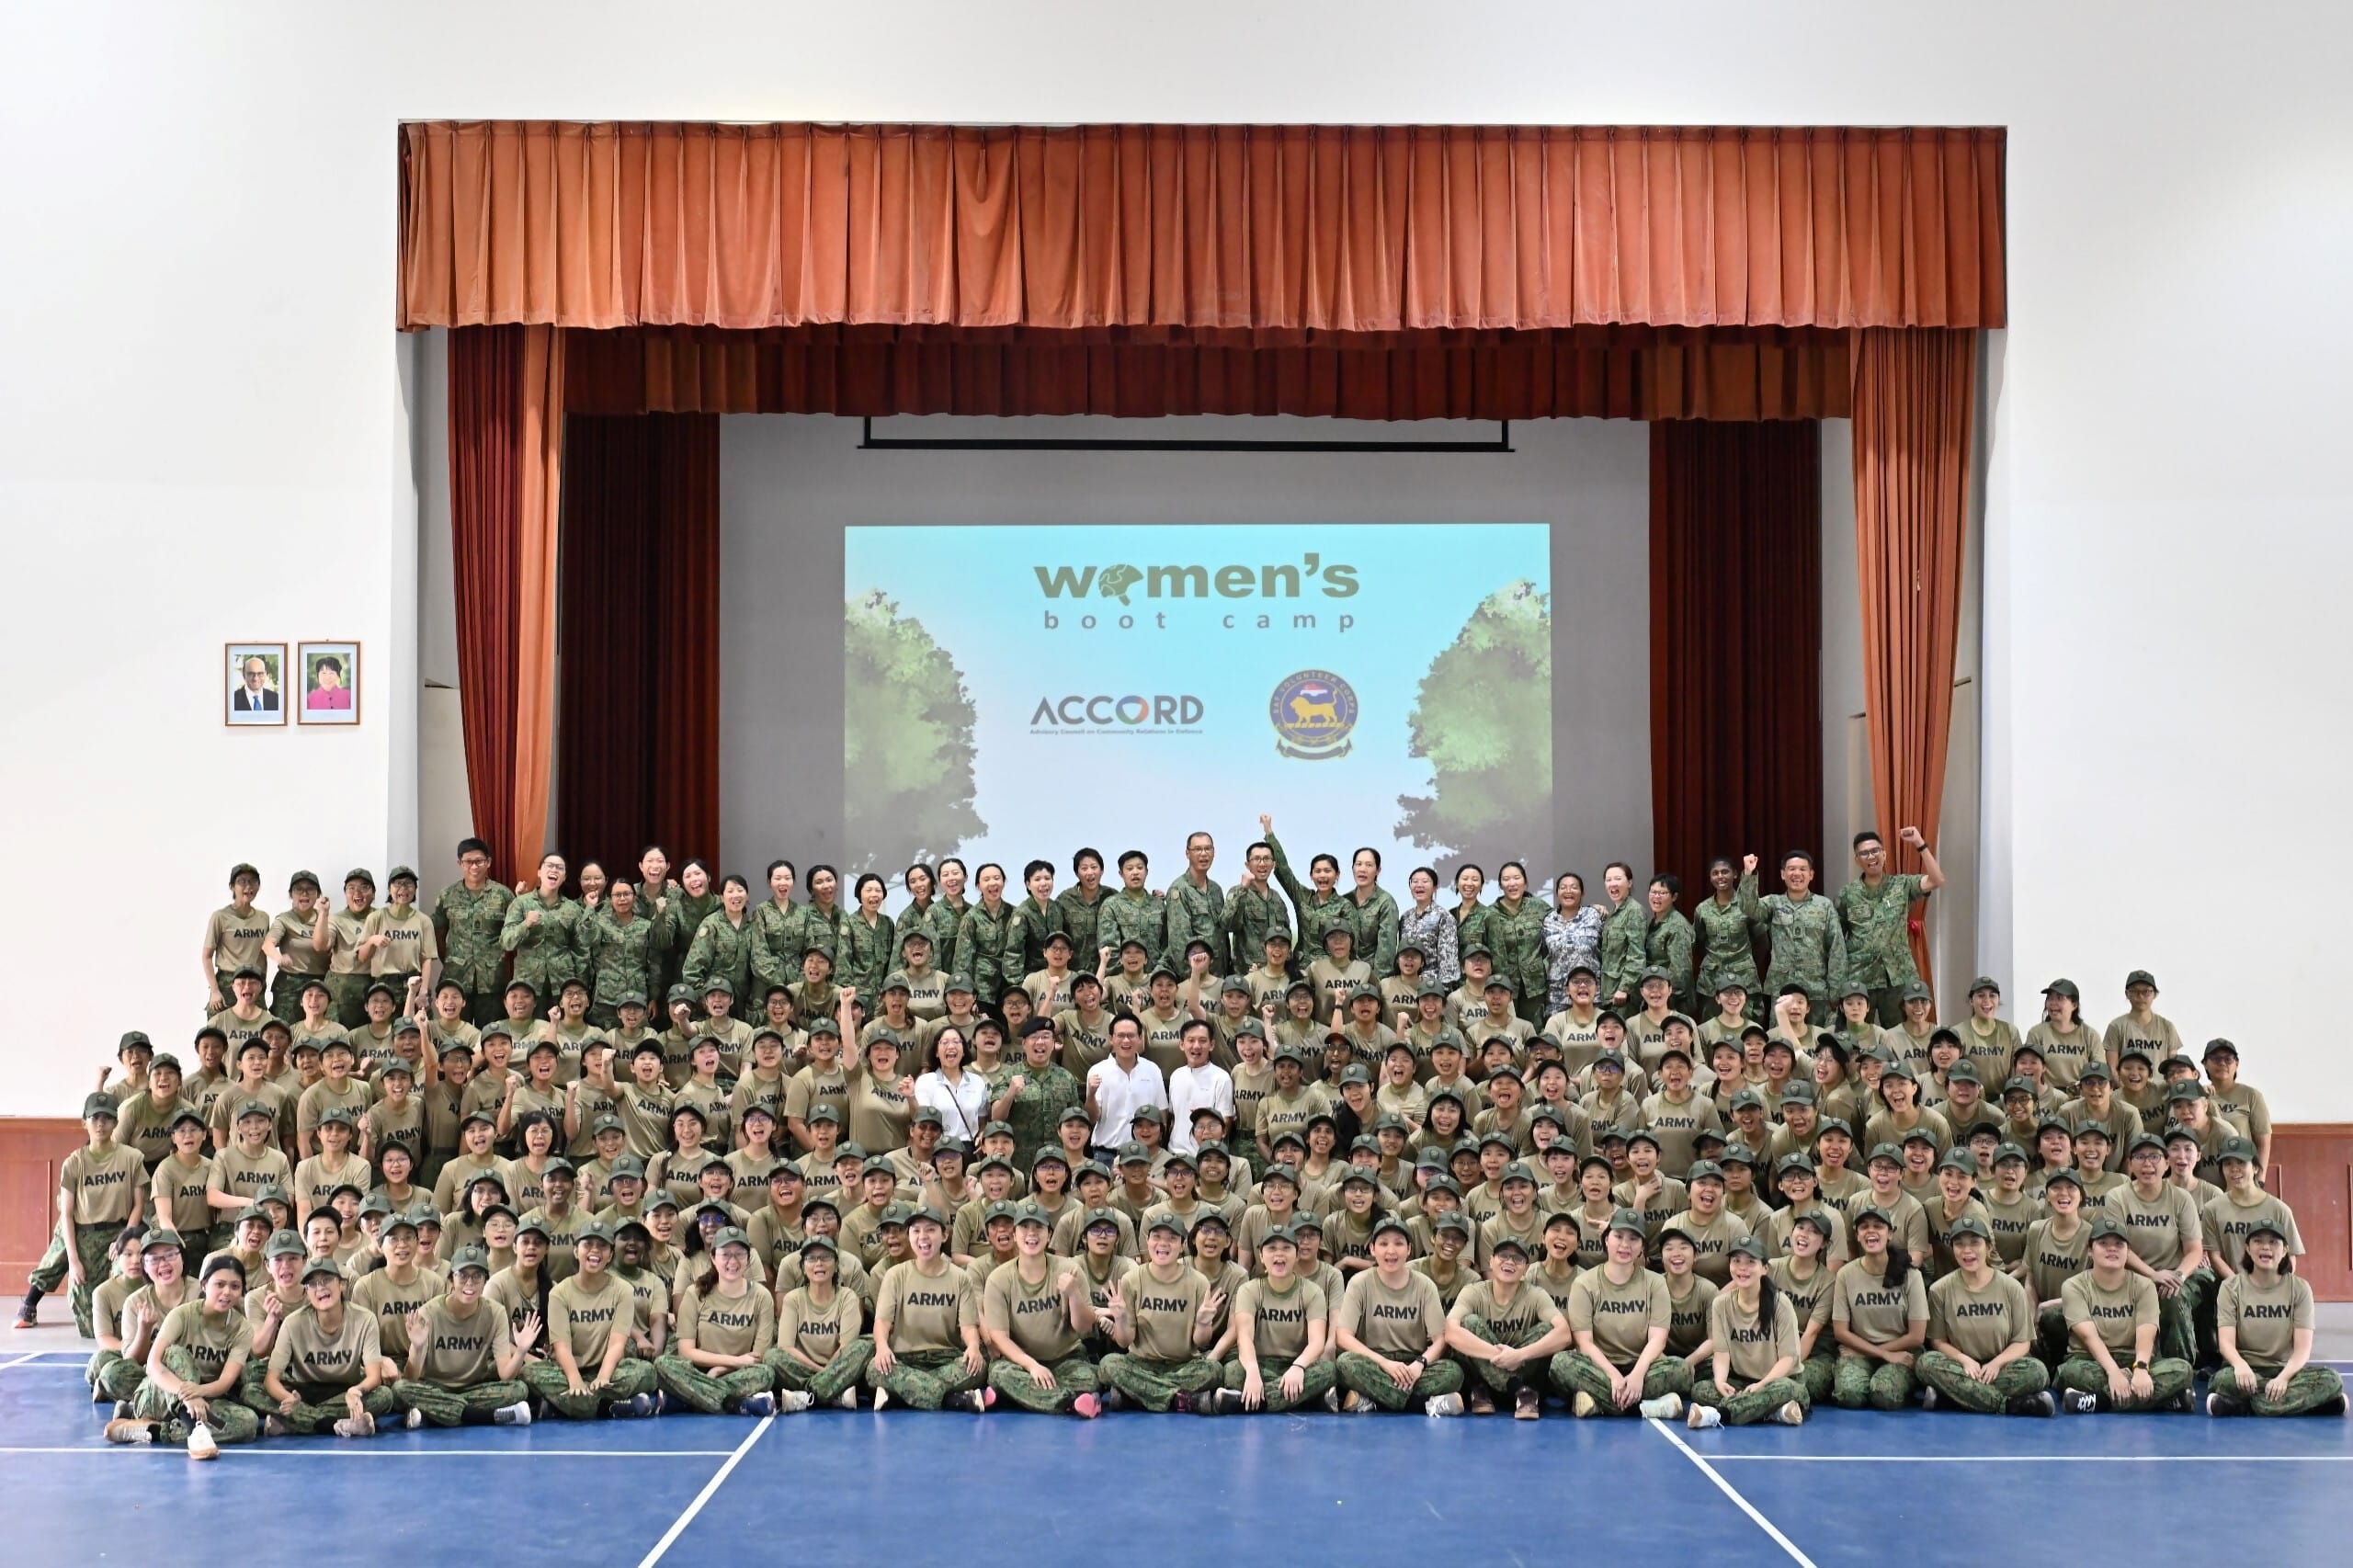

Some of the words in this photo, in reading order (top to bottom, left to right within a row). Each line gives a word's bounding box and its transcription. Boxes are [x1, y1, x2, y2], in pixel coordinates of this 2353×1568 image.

[1044, 610, 1166, 629] boot
[1222, 614, 1354, 632] camp
[1030, 695, 1204, 725] ACCORD
[233, 927, 266, 938] ARMY
[384, 929, 419, 940] ARMY
[1116, 994, 1150, 1006] ARY
[1261, 990, 1287, 1002] ARM
[1392, 994, 1419, 1005] ARM
[1072, 1029, 1106, 1048] ARMY
[1151, 1030, 1181, 1040] ARM
[1567, 1032, 1597, 1041] ARM
[1643, 1034, 1665, 1043] AR
[563, 1041, 582, 1051] AR
[718, 1042, 742, 1053] RMY
[897, 1040, 915, 1051] MY
[2047, 1044, 2085, 1055] ARMY
[2127, 1039, 2162, 1050] ARMY
[359, 1048, 394, 1059] ARMY
[1300, 1046, 1319, 1057] MY
[1416, 1047, 1431, 1057] AR
[1969, 1046, 2005, 1056] ARMY
[661, 1054, 689, 1063] ARM
[871, 1086, 905, 1103] ARMY
[345, 1106, 363, 1118] MY
[540, 1106, 565, 1118] ARM
[593, 1101, 618, 1112] ARM
[638, 1099, 674, 1118] ARMY
[1270, 1111, 1306, 1124] ARMY
[1655, 1116, 1695, 1129] ARMY
[141, 1127, 173, 1139] ARM
[386, 1126, 421, 1142] ARMY
[85, 1172, 126, 1186] ARMY
[236, 1171, 276, 1183] ARMY
[666, 1171, 699, 1183] ARM
[737, 1176, 768, 1187] ARM
[179, 1185, 207, 1197] ARM
[313, 1184, 335, 1195] AR
[2083, 1196, 2105, 1207] RM
[1992, 1219, 2023, 1233] RMY
[2126, 1215, 2169, 1227] ARMY
[2224, 1222, 2251, 1234] AR
[549, 1234, 575, 1245] RMY
[773, 1240, 801, 1251] ARM
[1342, 1243, 1371, 1256] ARM
[1577, 1240, 1608, 1252] ARM
[1697, 1241, 1722, 1253] RMY
[2039, 1252, 2078, 1269] ARMY
[633, 1288, 652, 1299] MY
[908, 1292, 956, 1306] ARMY
[1855, 1292, 1901, 1305] ARMY
[1017, 1293, 1061, 1313] ARMY
[1142, 1297, 1188, 1312] ARMY
[1600, 1301, 1645, 1313] ARMY
[569, 1308, 615, 1323] ARMY
[1260, 1307, 1302, 1322] ARMY
[1373, 1304, 1417, 1319] ARMY
[1957, 1302, 2003, 1317] ARMY
[2093, 1305, 2133, 1318] ARMY
[2244, 1305, 2293, 1318] ARMY
[708, 1311, 754, 1327] ARMY
[799, 1322, 840, 1334] ARMY
[1730, 1328, 1772, 1342] ARMY
[436, 1336, 483, 1350] ARMY
[304, 1348, 352, 1367] ARMY
